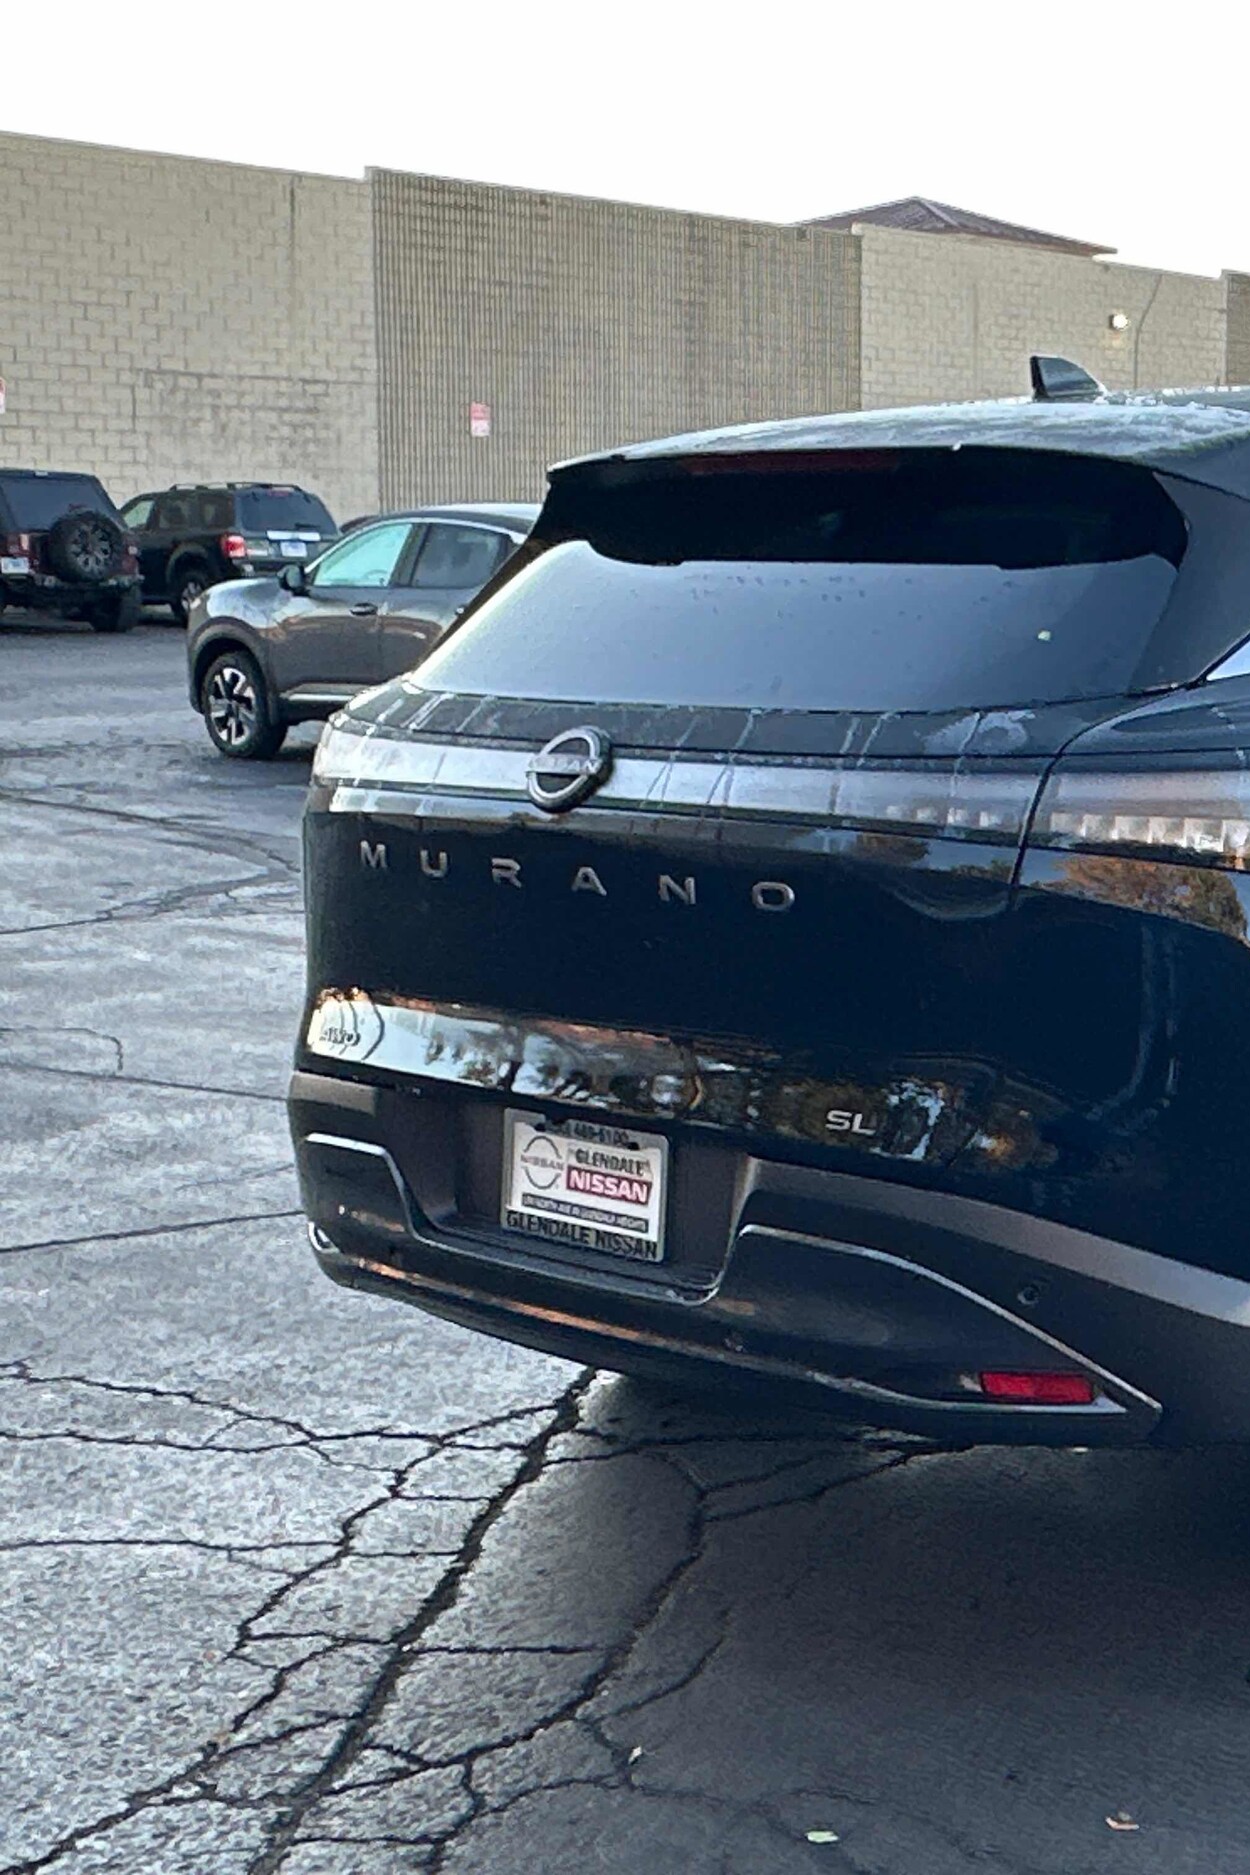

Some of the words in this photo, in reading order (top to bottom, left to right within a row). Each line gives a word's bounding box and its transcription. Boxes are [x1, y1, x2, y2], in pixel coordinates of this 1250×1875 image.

[360, 840, 796, 911] MURANO
[825, 1109, 876, 1135] SL
[575, 1149, 645, 1176] GLENDALE
[569, 1170, 648, 1203] NISSAN
[506, 1211, 590, 1245] GLENDALE
[595, 1230, 658, 1259] NISSAN
